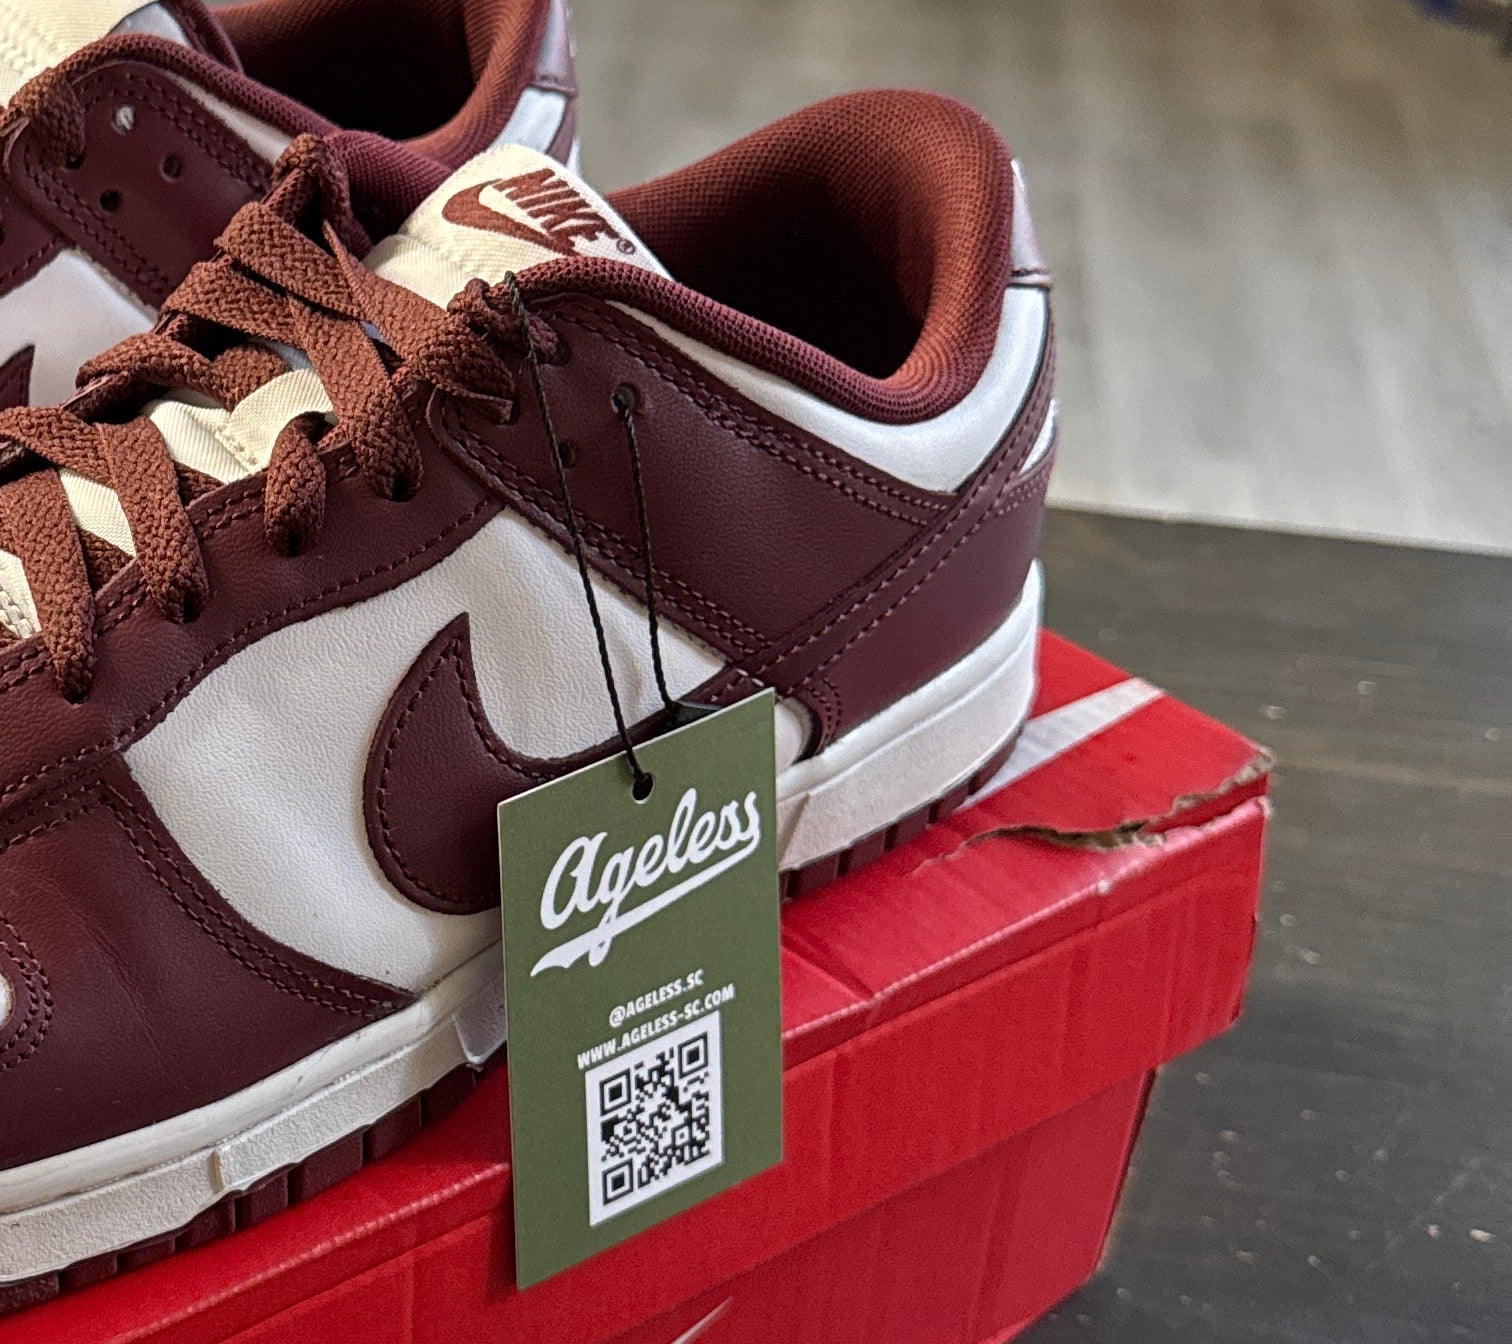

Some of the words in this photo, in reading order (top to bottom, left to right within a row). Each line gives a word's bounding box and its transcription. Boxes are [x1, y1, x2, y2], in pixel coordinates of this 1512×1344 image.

[492, 168, 620, 251] NIKE
[534, 787, 761, 971] Ageless
[576, 982, 736, 1070] WWW.AGELESS-SC.COM
[608, 968, 705, 1029] @AGELESS.SC
